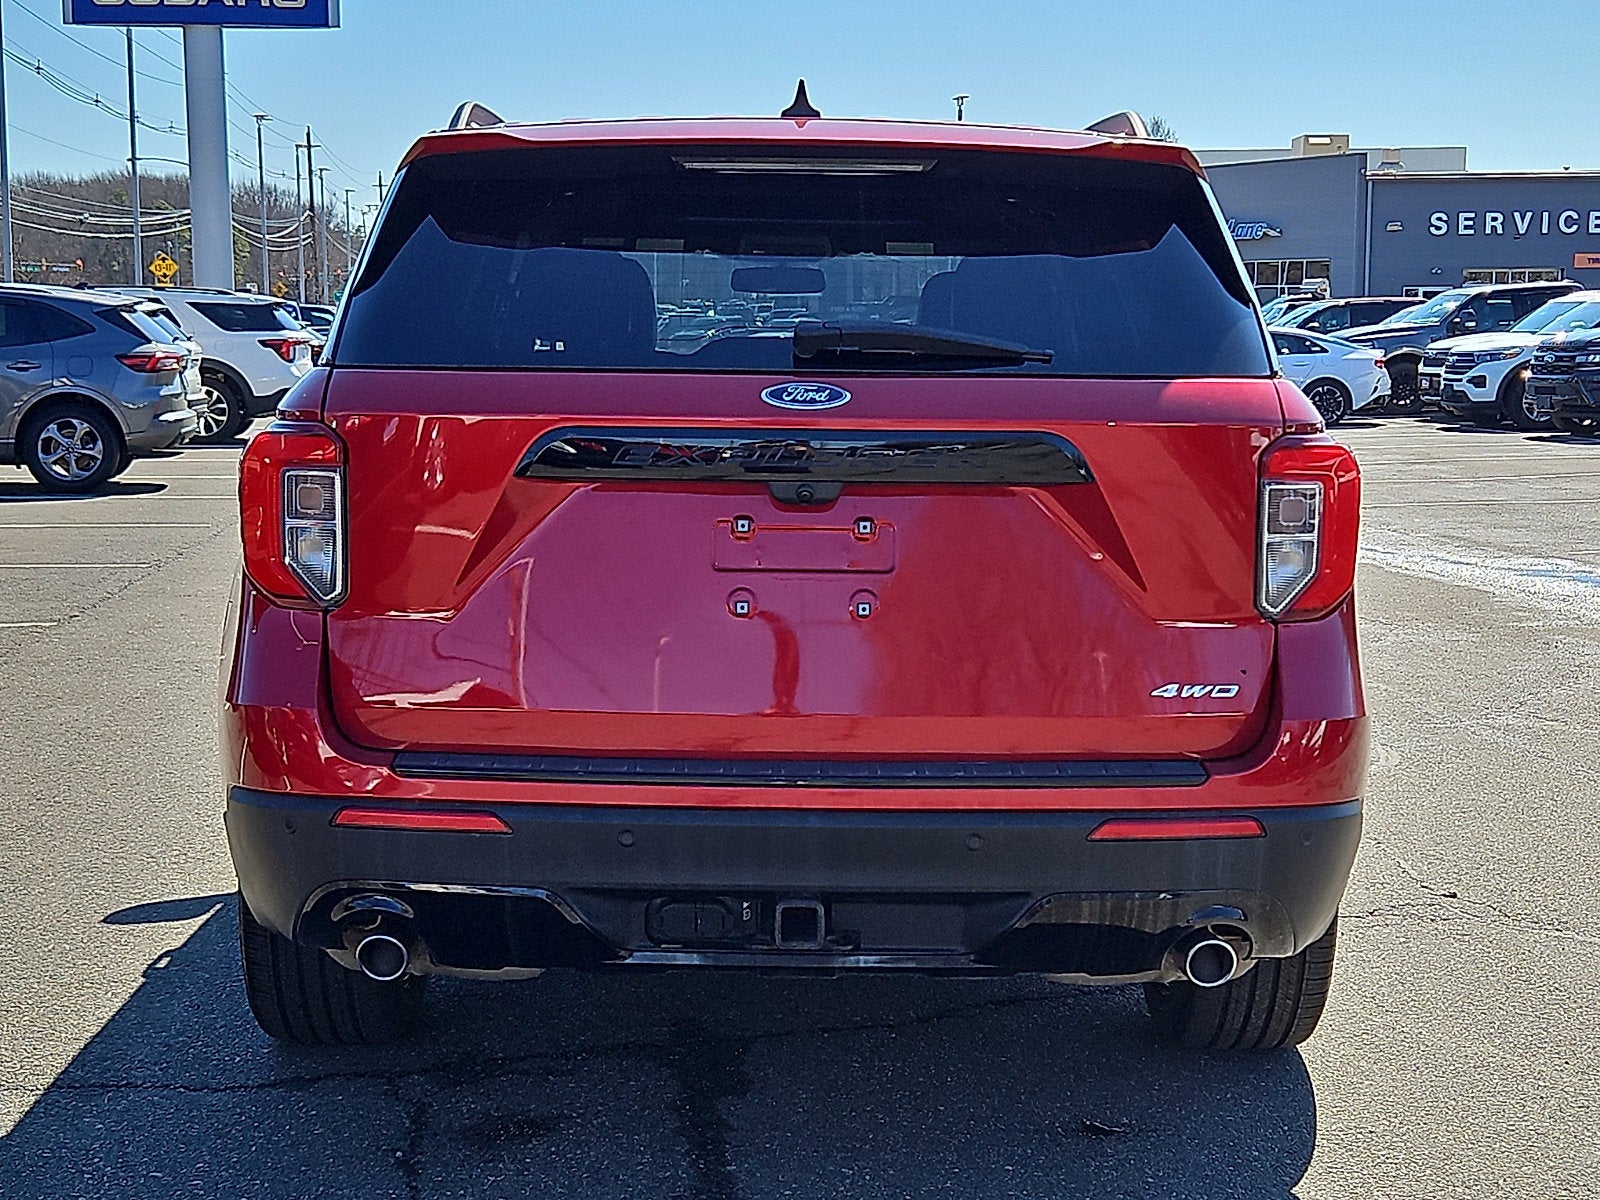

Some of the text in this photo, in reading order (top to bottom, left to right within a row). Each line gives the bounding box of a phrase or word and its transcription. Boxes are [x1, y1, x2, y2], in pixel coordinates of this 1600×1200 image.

[1429, 210, 1600, 236] SERVICE
[782, 385, 831, 401] Ford
[1150, 683, 1240, 698] 4WD
